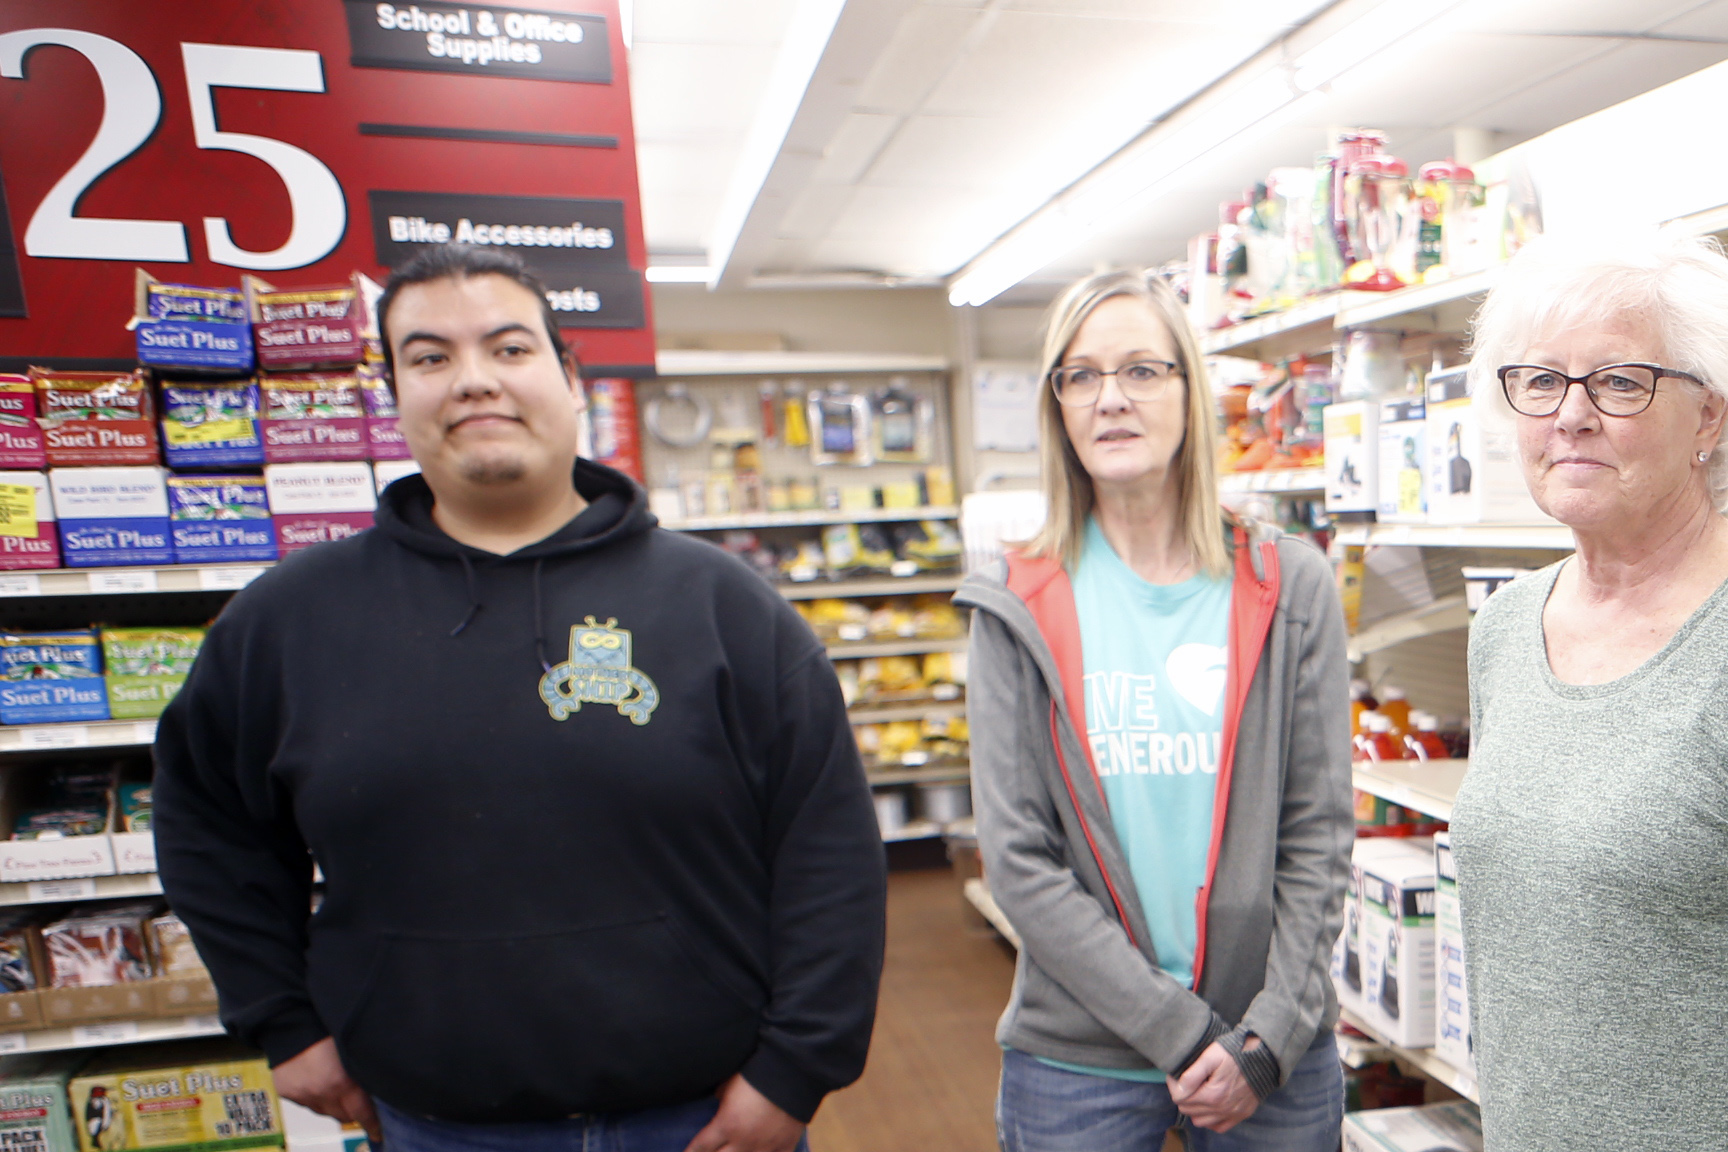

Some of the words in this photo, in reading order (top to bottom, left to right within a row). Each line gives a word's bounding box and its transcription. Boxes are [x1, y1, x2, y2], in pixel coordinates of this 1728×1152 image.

[376, 3, 471, 36] School
[477, 10, 499, 37] &
[504, 13, 584, 44] Office
[426, 32, 542, 66] Supplies
[0, 27, 348, 271] 25
[389, 216, 450, 243] Bike
[455, 218, 614, 249] Accessories
[141, 328, 190, 349] Suet
[191, 330, 239, 350] Plus
[259, 326, 303, 347] Suet
[306, 324, 351, 344] Plus
[47, 430, 94, 448] Suet
[99, 429, 147, 448] Plus
[266, 425, 312, 445] Suet
[315, 423, 360, 444] Plus
[3, 537, 51, 552] Plus
[66, 531, 116, 551] Suet
[119, 531, 166, 550] Plus
[173, 529, 221, 548] Suet
[223, 529, 269, 546] Plus
[281, 526, 328, 545] Suet
[2, 687, 50, 706] Suet
[54, 686, 101, 704] Plus
[1083, 671, 1160, 735] IVE
[1087, 731, 1220, 777] ENEROU
[122, 1075, 181, 1101] Suet
[186, 1070, 243, 1095] Plus
[12, 1090, 54, 1107] Plus
[1, 1128, 46, 1146] PACK
